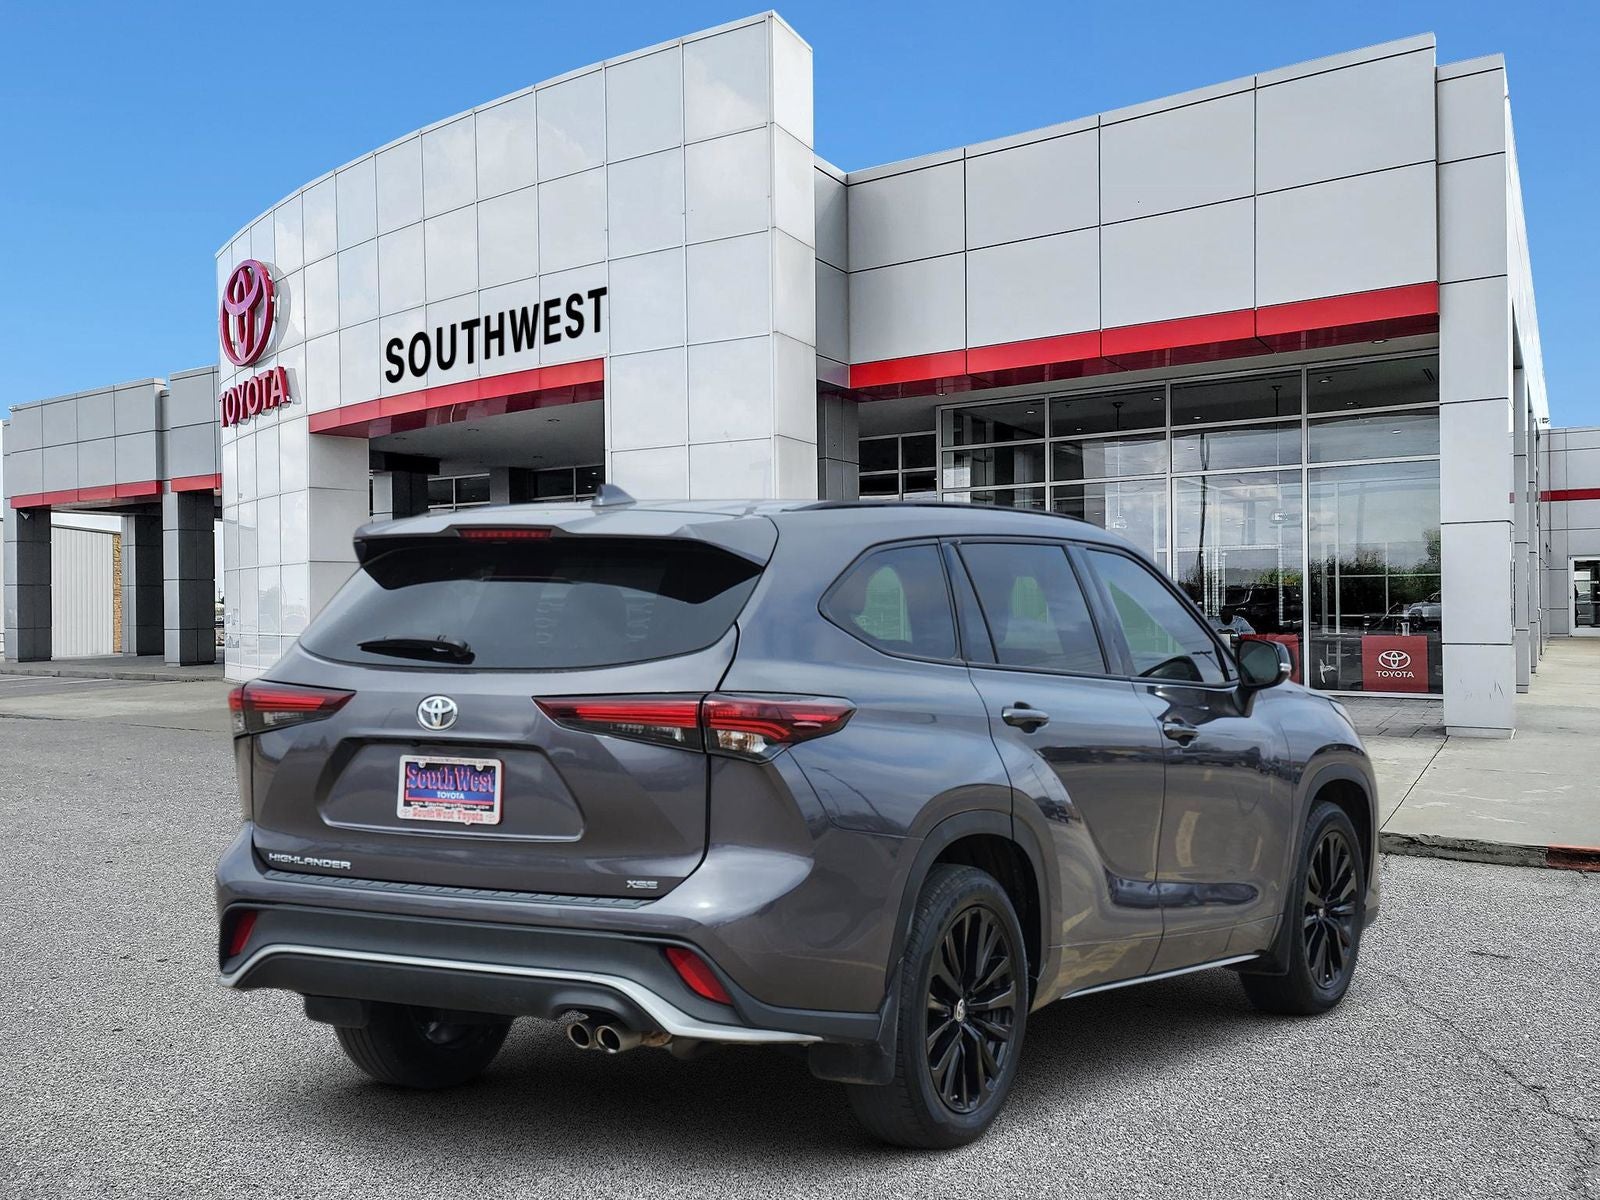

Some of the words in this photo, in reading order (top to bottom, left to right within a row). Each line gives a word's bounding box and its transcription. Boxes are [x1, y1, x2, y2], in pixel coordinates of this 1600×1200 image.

[384, 286, 608, 383] SOUTHWEST
[219, 366, 291, 428] TOYOTA
[1376, 670, 1414, 678] TOYOTA
[457, 810, 484, 822] Toyota
[269, 853, 351, 869] HIGHLANDER
